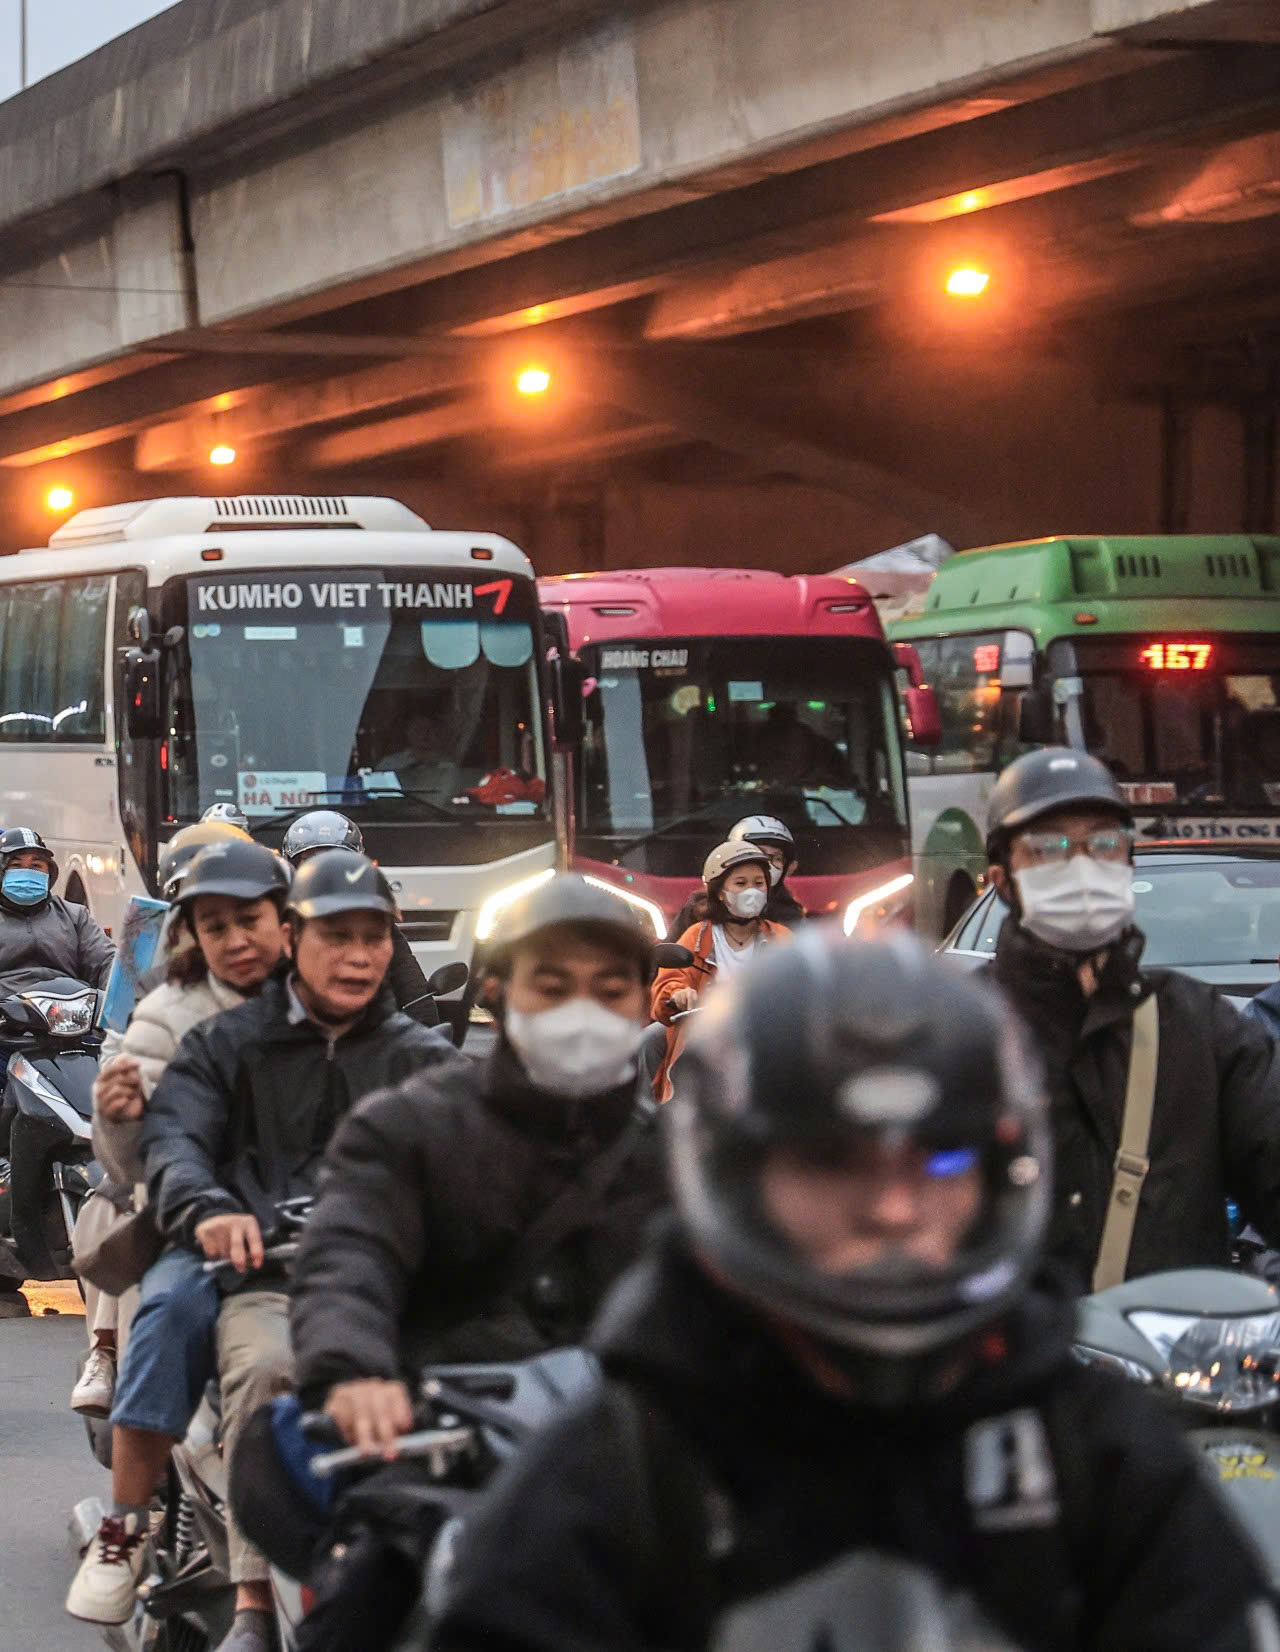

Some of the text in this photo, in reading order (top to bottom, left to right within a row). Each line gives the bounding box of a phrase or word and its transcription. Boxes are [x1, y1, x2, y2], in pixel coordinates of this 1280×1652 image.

[198, 583, 473, 610] KUMHO VIET THANH
